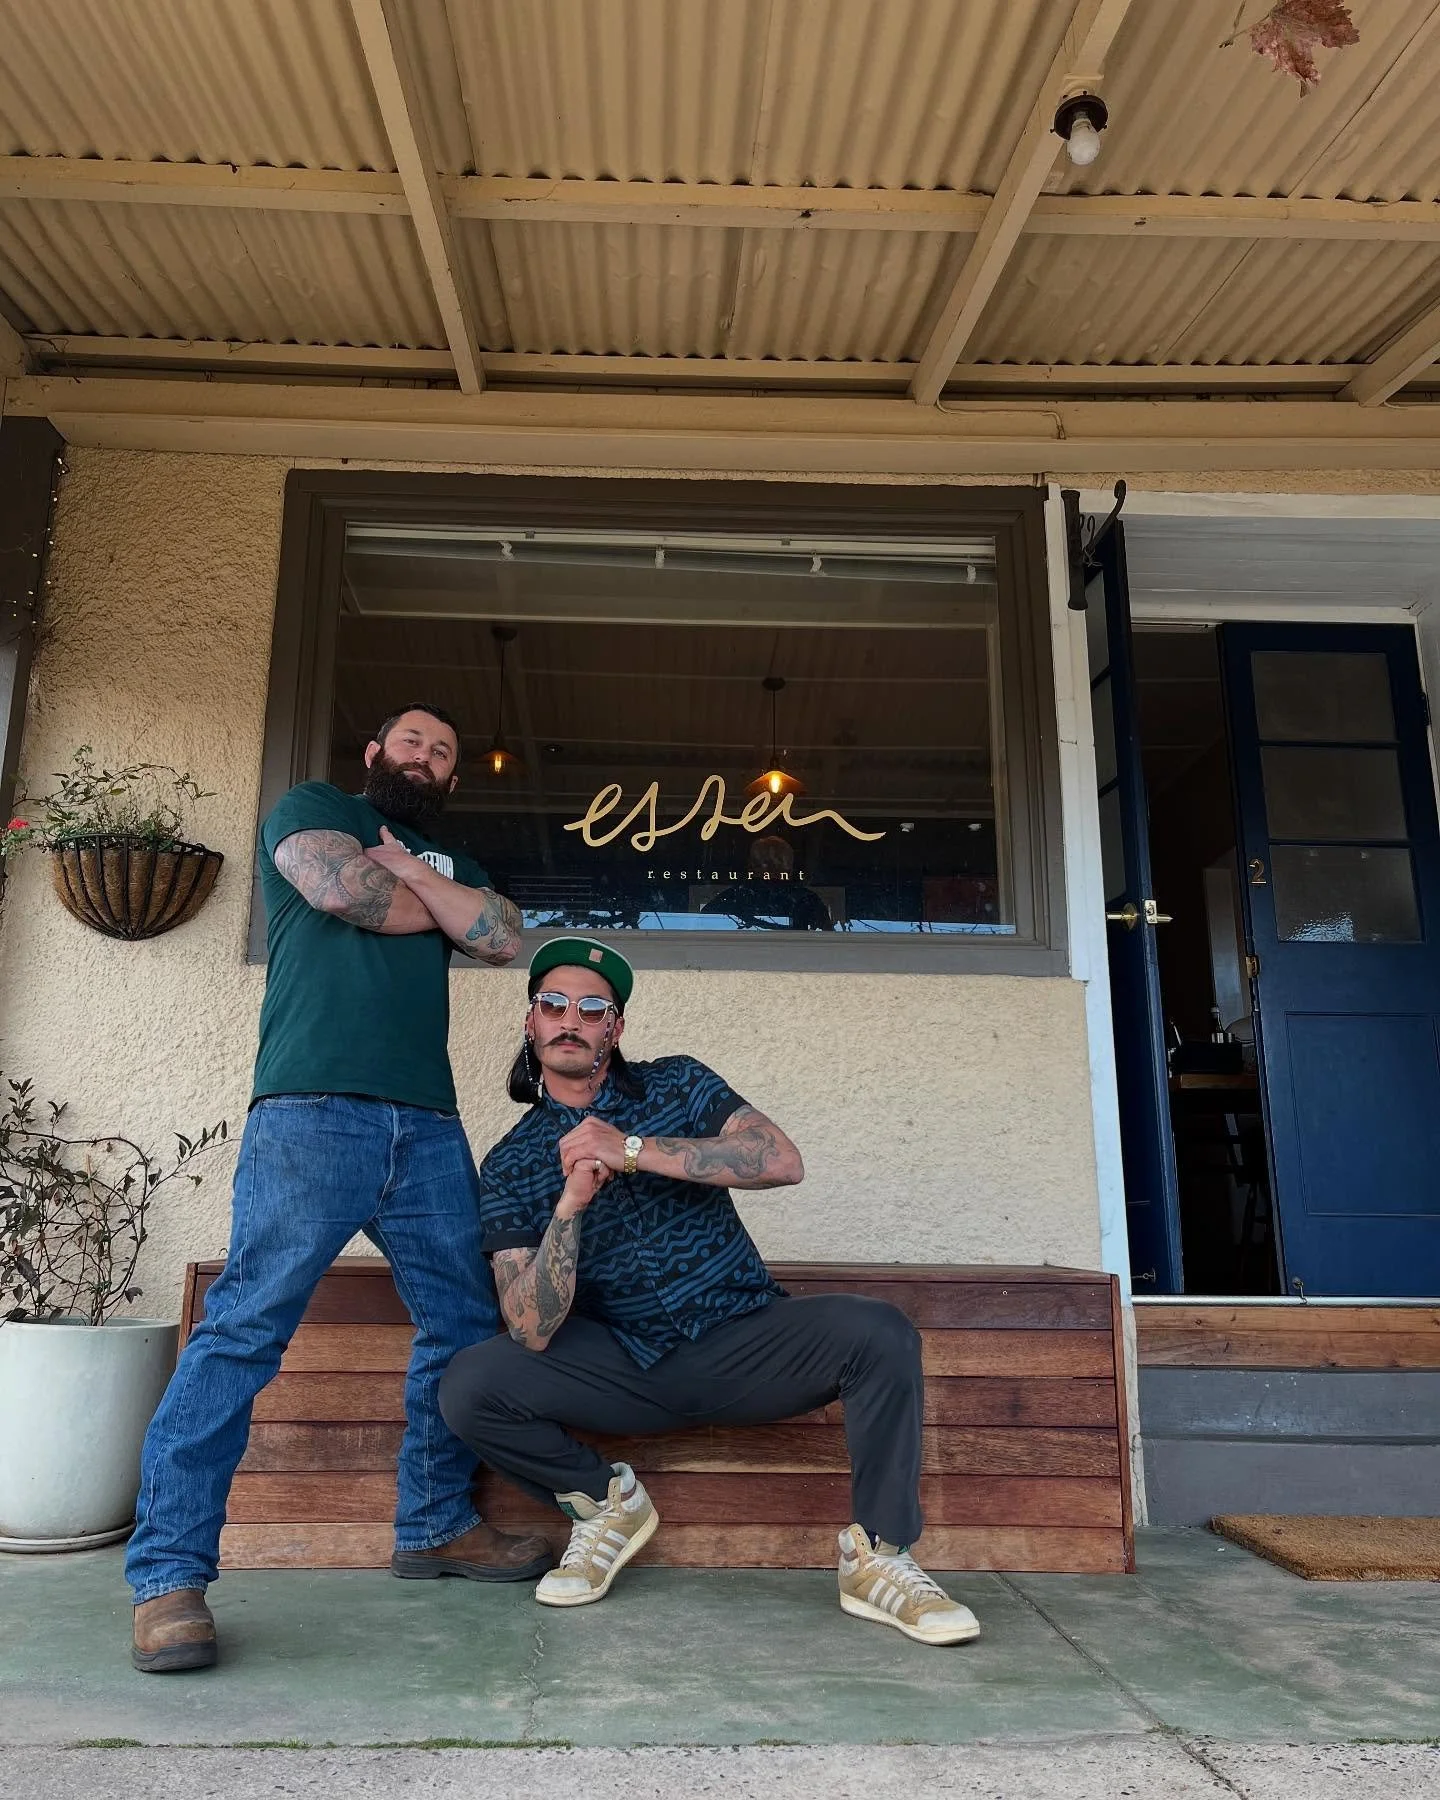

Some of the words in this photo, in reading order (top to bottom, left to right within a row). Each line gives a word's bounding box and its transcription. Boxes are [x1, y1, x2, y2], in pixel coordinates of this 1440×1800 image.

[563, 774, 887, 852] essen
[647, 869, 804, 881] restaurant
[1249, 859, 1267, 884] 2
